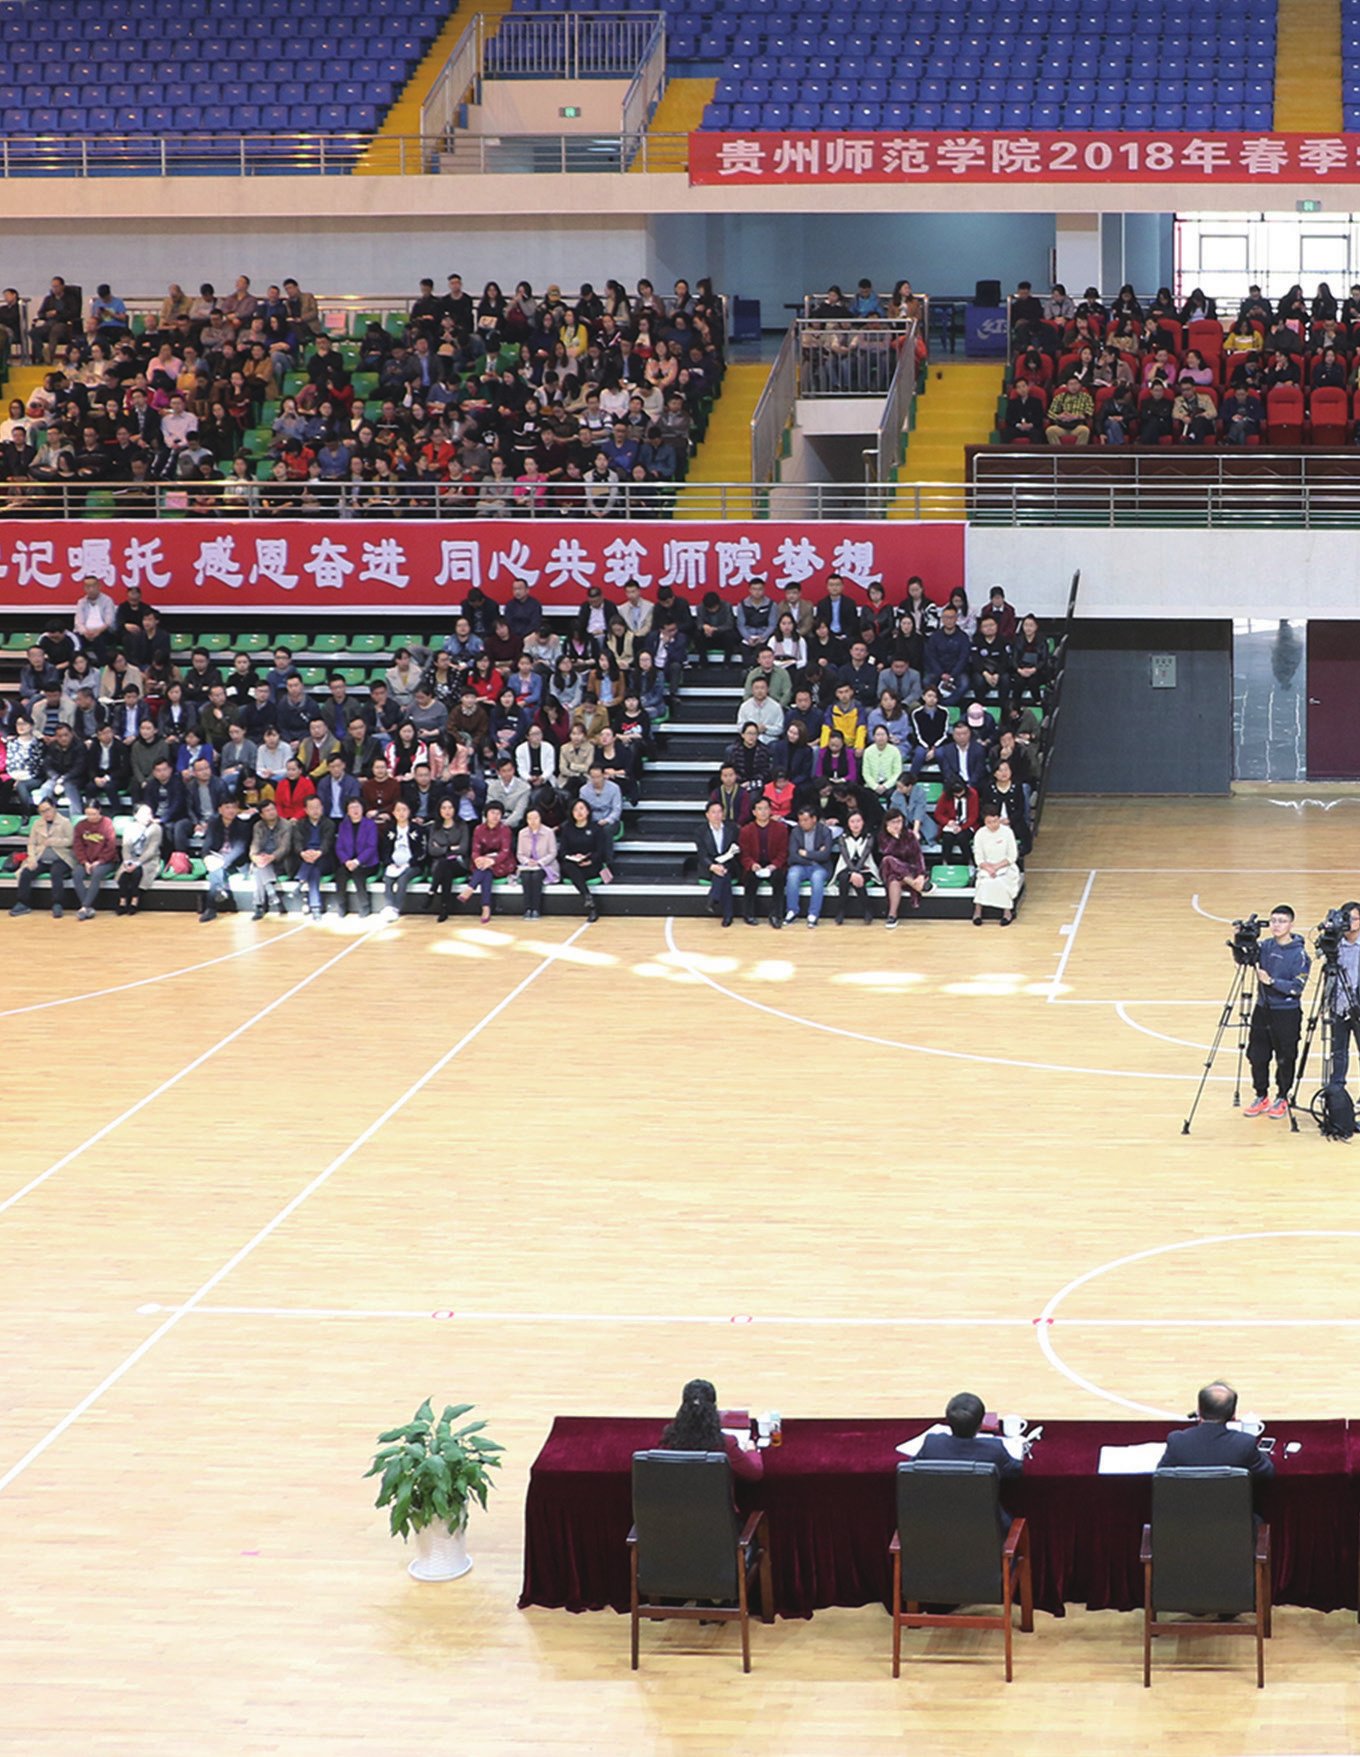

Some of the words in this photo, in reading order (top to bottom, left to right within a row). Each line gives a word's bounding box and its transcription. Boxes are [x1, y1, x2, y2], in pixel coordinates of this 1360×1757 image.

[0, 537, 172, 588] 记嘱托
[193, 535, 411, 589] 感恩奋进
[434, 536, 884, 589] 同心共筑师院梦想
